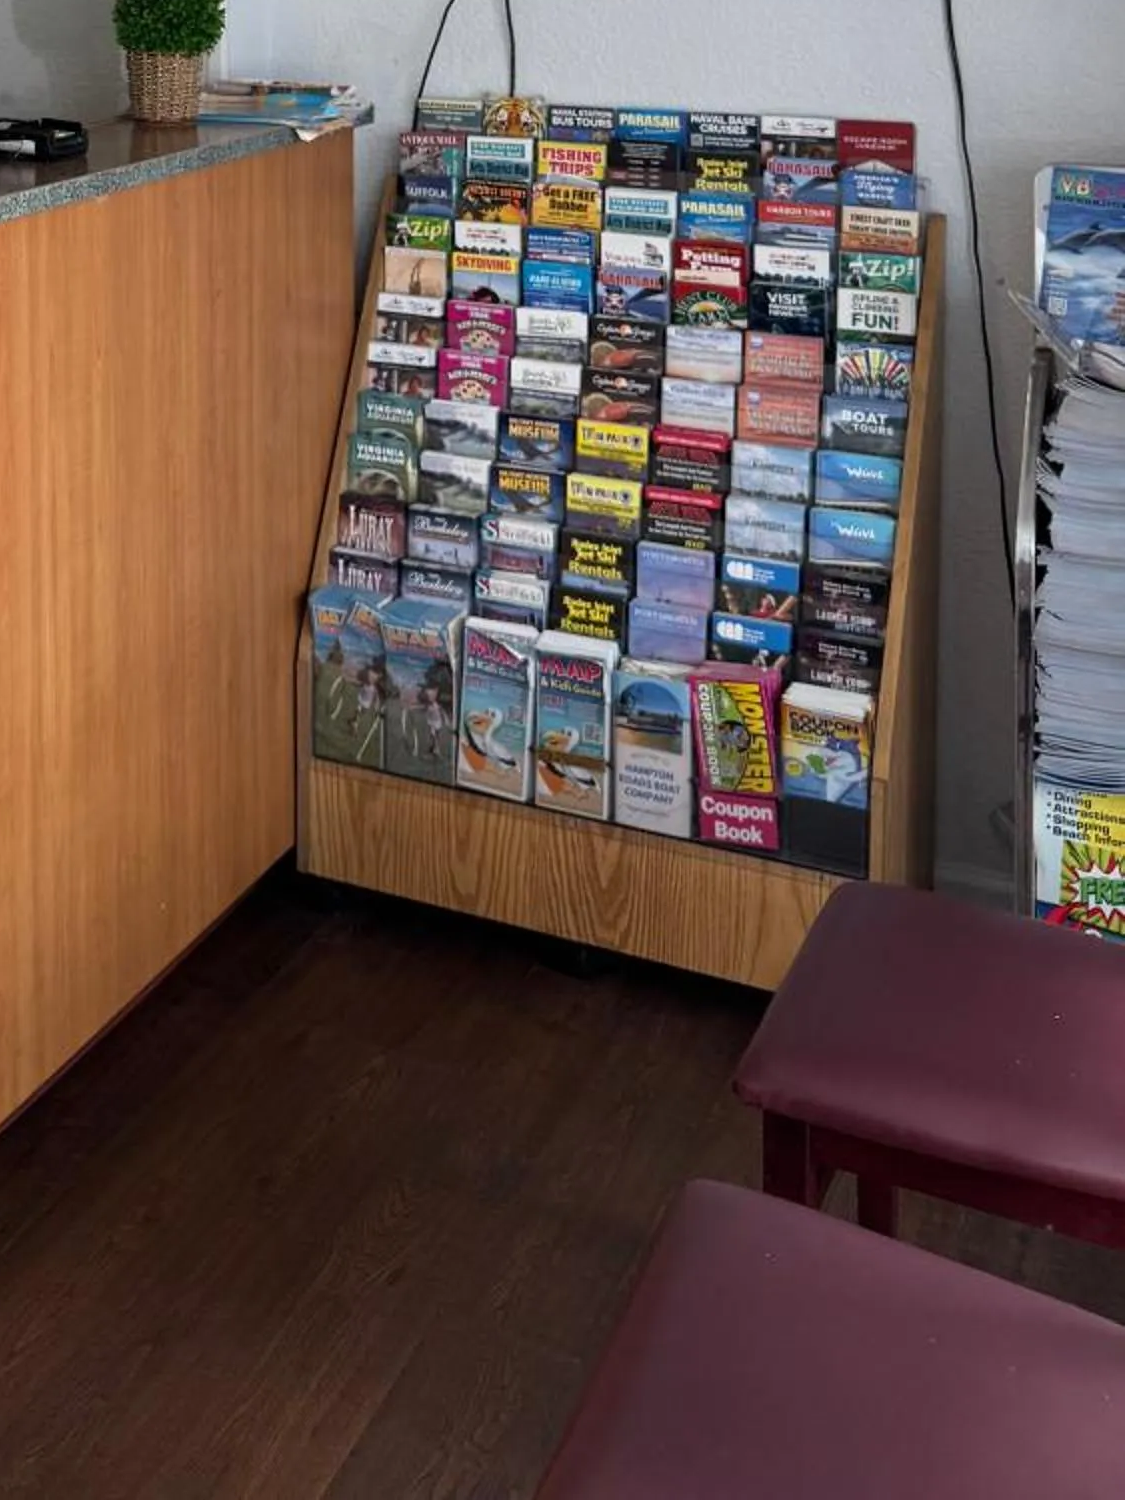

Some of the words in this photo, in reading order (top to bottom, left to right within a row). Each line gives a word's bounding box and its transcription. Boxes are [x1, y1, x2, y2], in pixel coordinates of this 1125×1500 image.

[551, 116, 574, 127] BUS
[576, 117, 613, 129] TOURS
[618, 113, 681, 129] PARASAIL
[690, 115, 726, 125] NAVAL
[728, 115, 756, 127] BASE
[699, 123, 748, 135] CRUISES
[542, 147, 602, 164] FISHING
[549, 161, 594, 177] TRIPS
[681, 201, 746, 219] PARASAIL
[410, 220, 451, 241] Zip!
[454, 256, 512, 273] SKYDIVING
[680, 248, 742, 269] Petting
[866, 257, 915, 281] Zip!
[766, 291, 807, 305] VISIT
[851, 313, 900, 332] FUN!
[367, 403, 414, 417] VIRGINIA
[842, 408, 888, 425] BOAT
[508, 422, 560, 442] MUSEUM
[852, 423, 894, 437] TOURS
[356, 443, 404, 457] VIRGINIA
[698, 683, 716, 743] COUPON
[789, 711, 859, 734] COUPON
[720, 681, 775, 793] MONSTER
[624, 764, 674, 781] HAMPTON
[624, 786, 673, 805] COMPANY
[700, 794, 774, 823] Coupon
[714, 819, 764, 844] Book
[1052, 814, 1110, 837] Shopping
[1053, 826, 1090, 842] Beach
